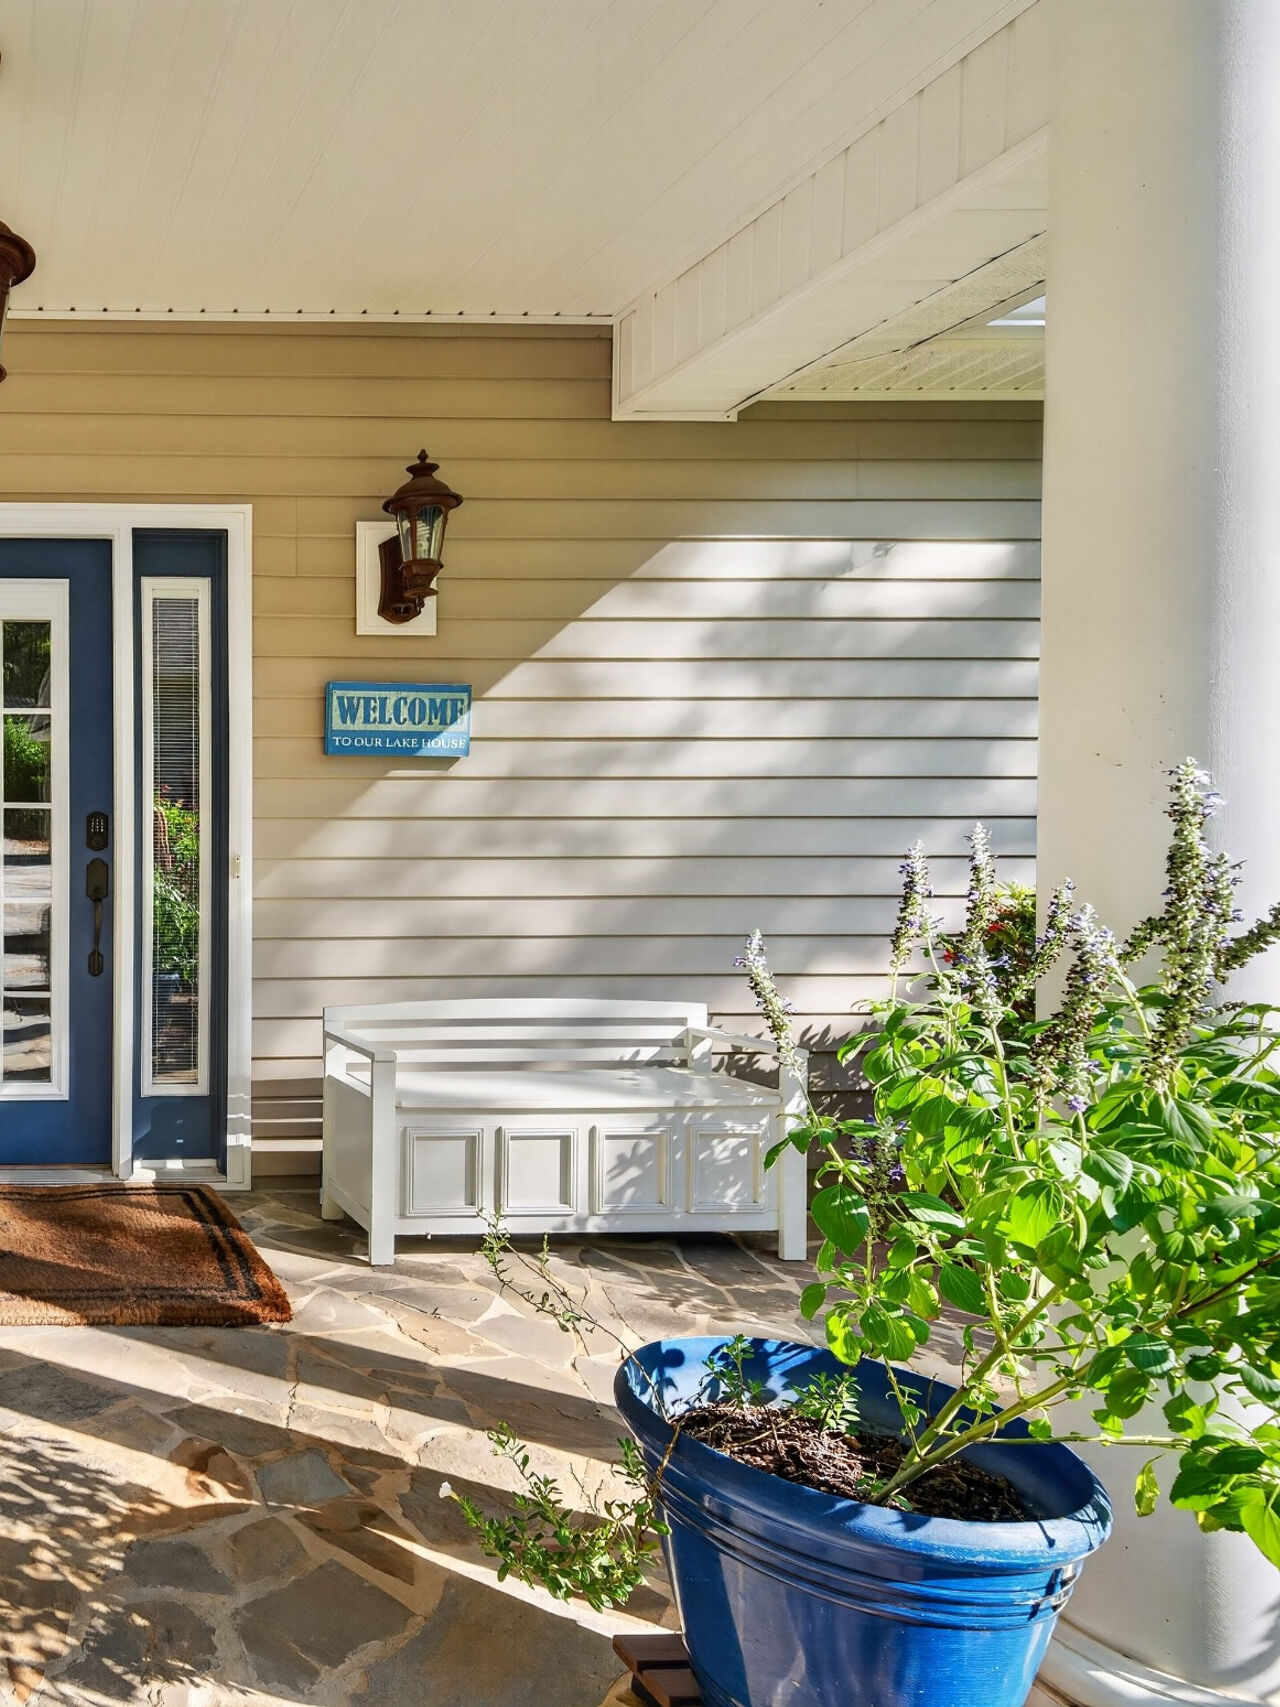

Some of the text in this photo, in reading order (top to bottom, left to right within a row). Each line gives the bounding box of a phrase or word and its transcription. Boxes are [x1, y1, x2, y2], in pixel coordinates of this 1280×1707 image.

[336, 695, 465, 726] WELCOME
[332, 736, 466, 749] TO OUR LAKE HOUSE
